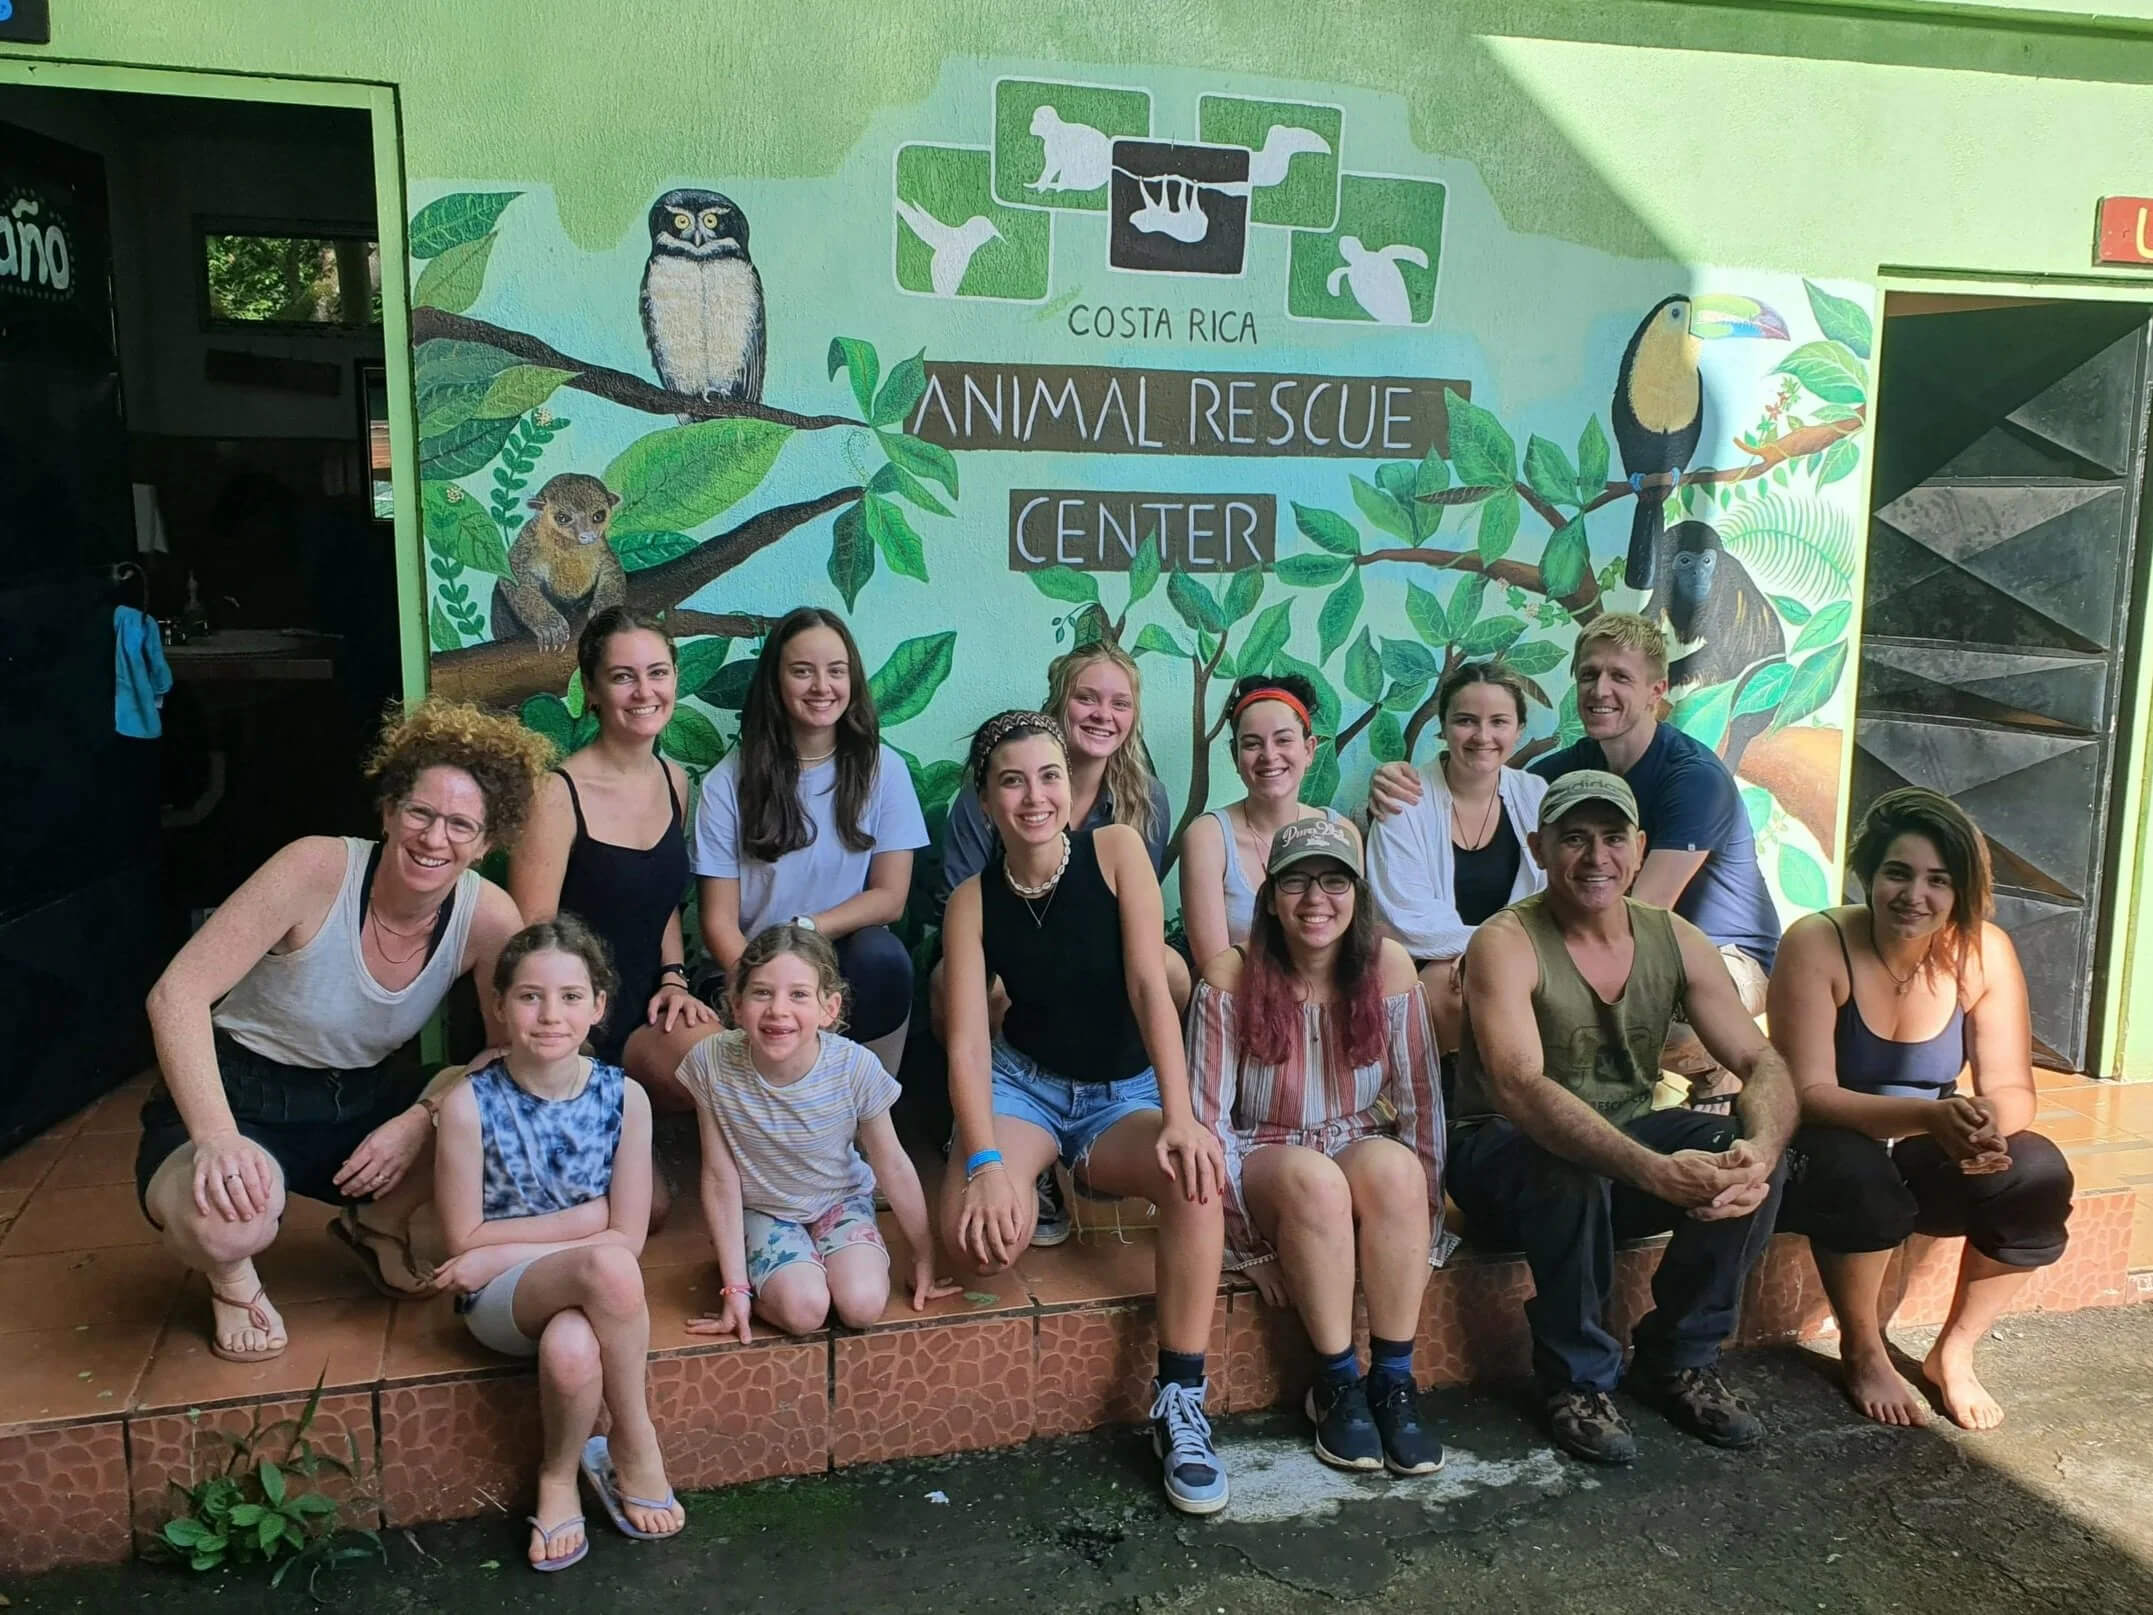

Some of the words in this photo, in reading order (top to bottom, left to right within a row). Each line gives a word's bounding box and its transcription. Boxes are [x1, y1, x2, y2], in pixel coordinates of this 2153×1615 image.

[1068, 304, 1172, 339] COSTA
[1189, 307, 1258, 344] RICA
[912, 373, 1163, 448] ANIMAL
[1189, 377, 1413, 449] RESCUE
[1015, 496, 1263, 565] CENTER
